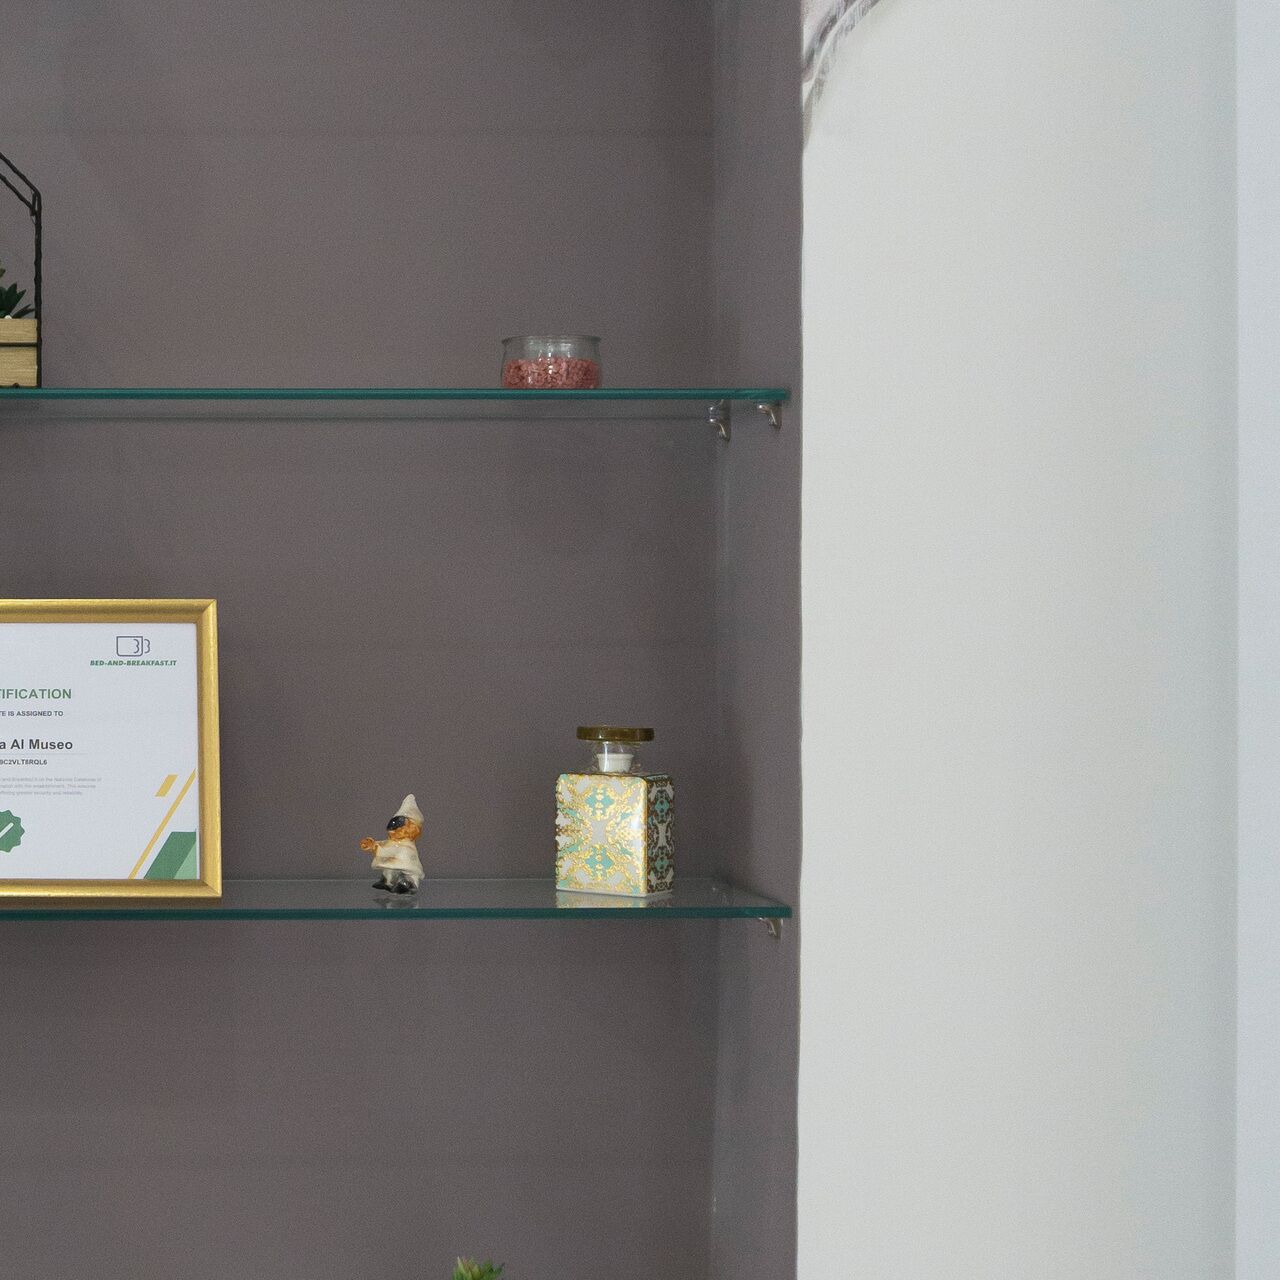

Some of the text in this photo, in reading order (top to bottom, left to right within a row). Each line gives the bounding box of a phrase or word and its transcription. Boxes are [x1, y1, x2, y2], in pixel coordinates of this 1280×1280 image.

[90, 659, 178, 667] BED-AND-BREAKFAST.IT
[10, 738, 25, 750] Al
[29, 738, 73, 750] Museo
